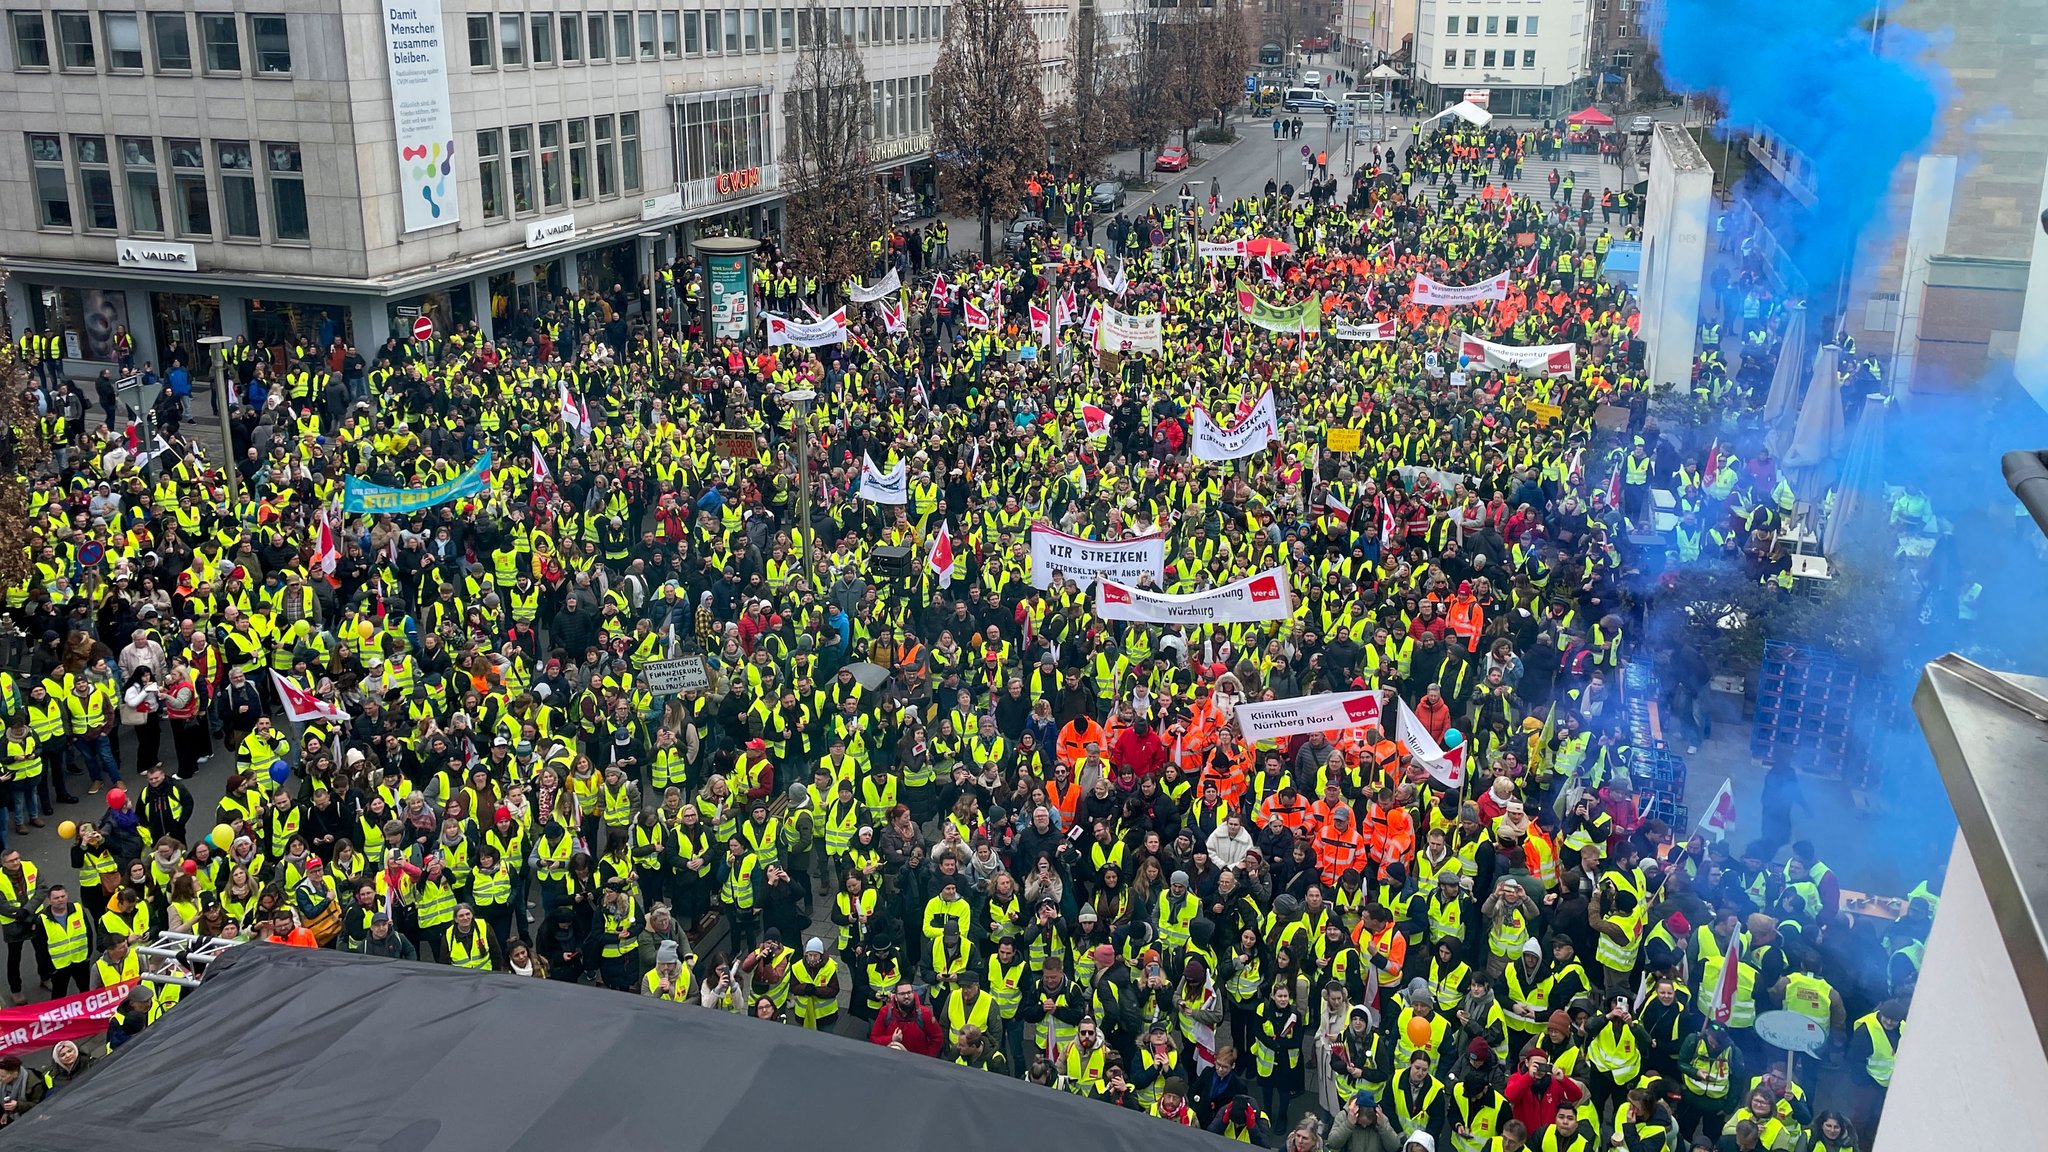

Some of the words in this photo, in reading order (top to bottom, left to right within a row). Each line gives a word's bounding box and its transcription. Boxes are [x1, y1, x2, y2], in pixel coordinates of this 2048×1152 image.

[390, 8, 417, 20] Damit
[391, 22, 435, 35] Menschen
[392, 39, 438, 50] zusammen
[394, 51, 430, 64] bleiben.
[866, 136, 929, 163] UCHHANDLUNG
[716, 166, 760, 195] CVJM
[546, 222, 574, 236] VAUDE
[141, 251, 188, 263] VAUDE
[1049, 544, 1072, 559] WIR
[1081, 549, 1148, 563] STREIKEN!
[1045, 561, 1118, 577] BEZIRKSKLINKUM
[1121, 569, 1155, 577] ANSBH
[1121, 594, 1130, 602] di
[1268, 589, 1277, 597] di
[1168, 605, 1214, 618] Würzburg
[644, 659, 699, 671] KOSTENDECKENDE
[649, 667, 703, 679] FINANZIERUNG
[666, 675, 687, 683] STATT
[651, 679, 708, 692] FALLPAUSCHALEN
[1250, 708, 1298, 721] Klinikum
[1350, 710, 1367, 718] ver
[1367, 708, 1378, 716] di
[1253, 717, 1305, 731] Nürnberg
[1306, 714, 1334, 727] Nord
[38, 1000, 85, 1022] MEHR
[85, 984, 130, 1013] GELD
[0, 1027, 29, 1052] EHR
